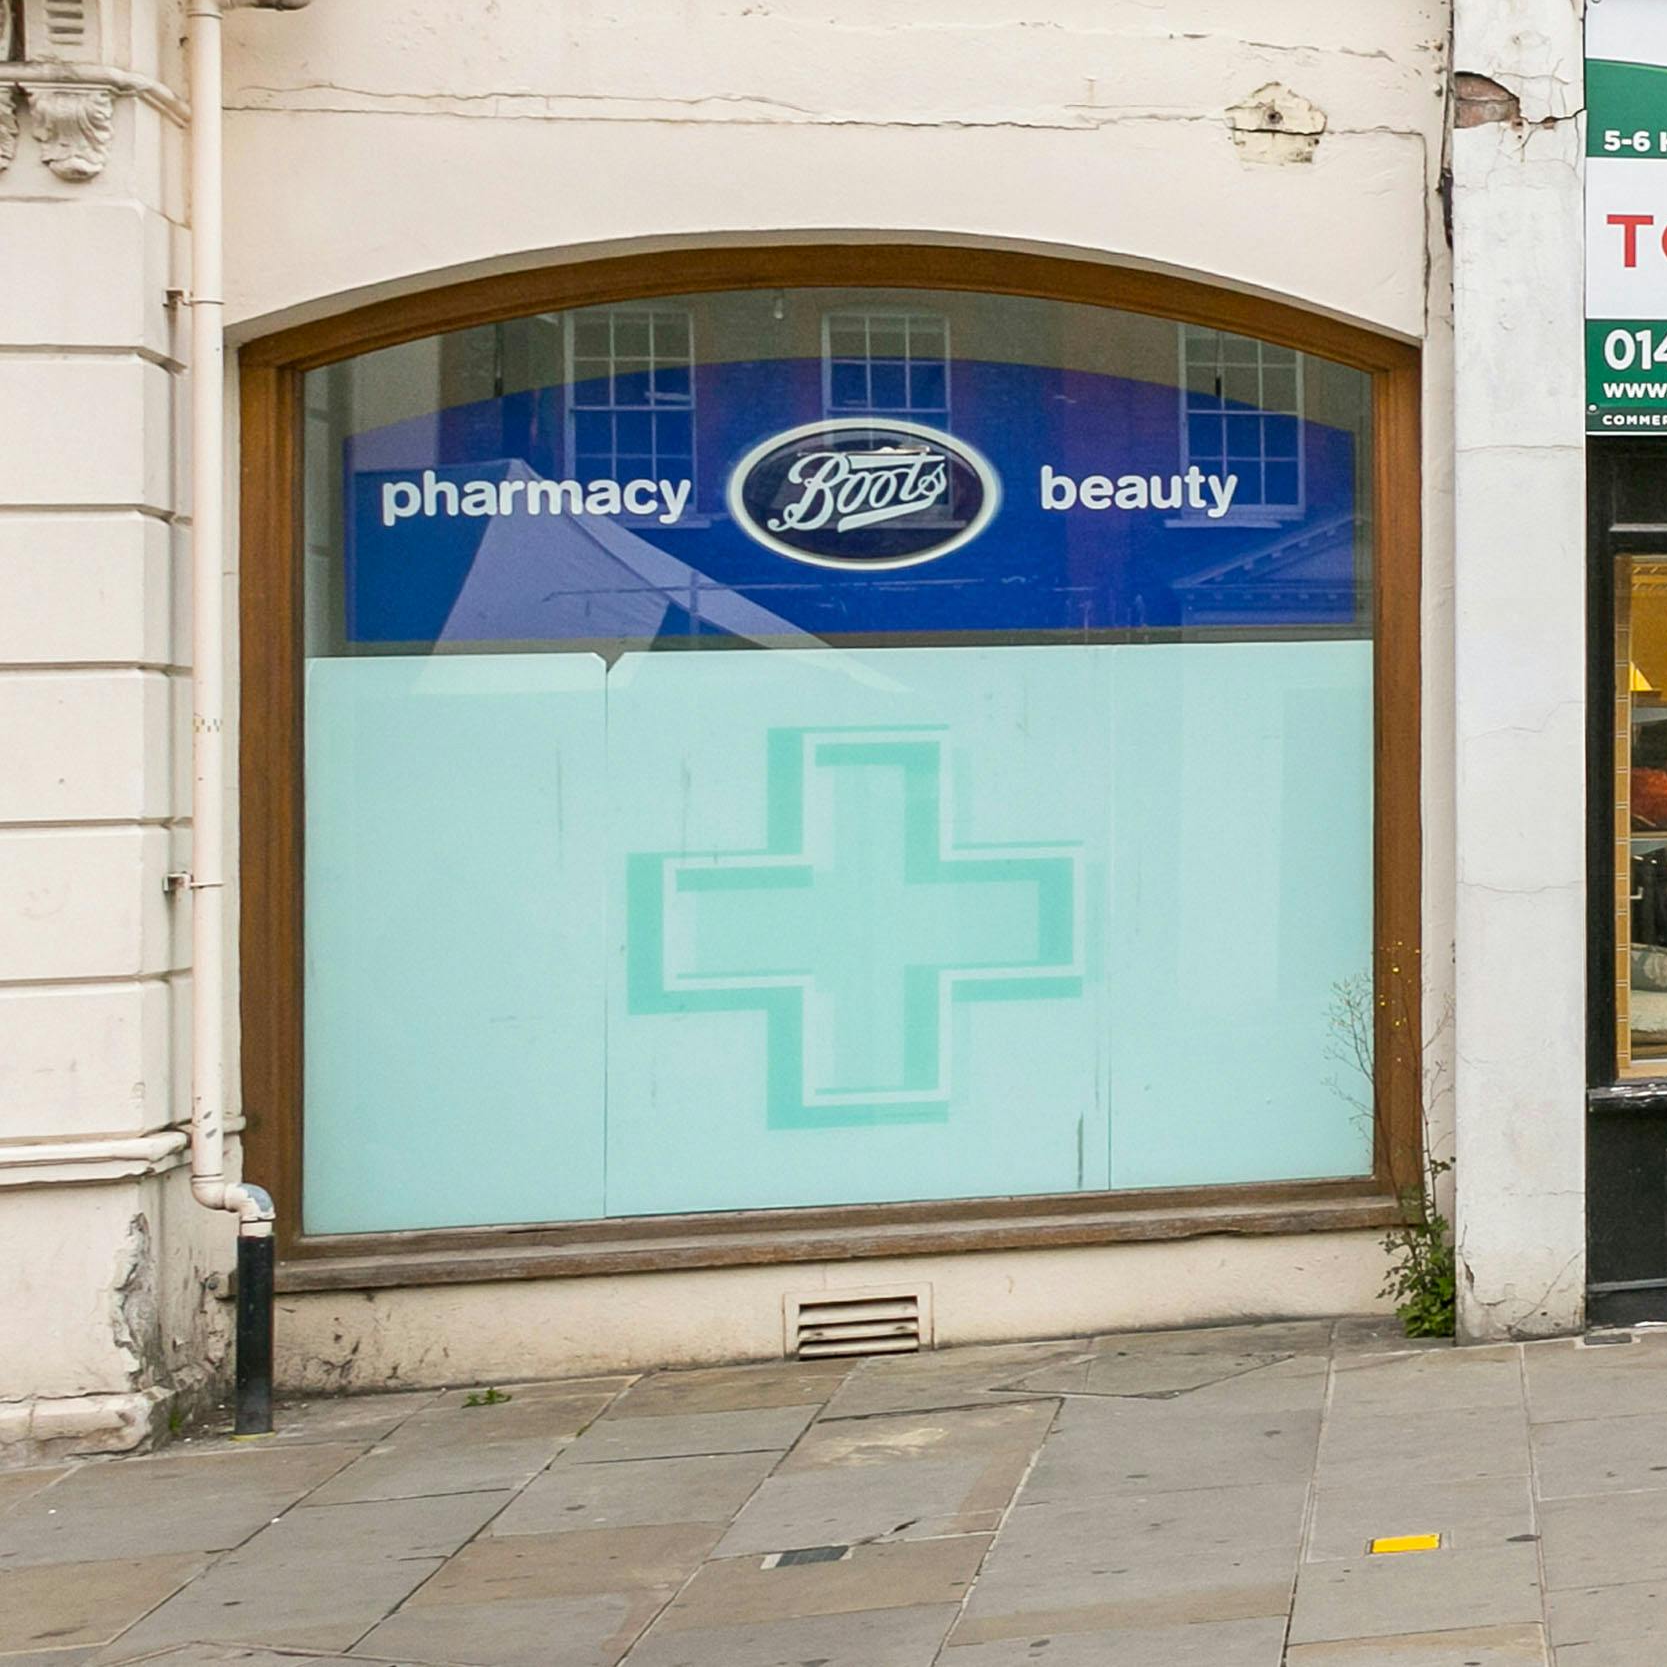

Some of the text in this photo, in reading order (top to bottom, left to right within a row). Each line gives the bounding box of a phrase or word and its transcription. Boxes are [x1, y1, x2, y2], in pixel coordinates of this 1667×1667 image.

[1603, 130, 1651, 152] 5-6
[381, 467, 692, 526] pharmacy
[767, 444, 950, 534] Boots
[1039, 464, 1237, 520] beauty
